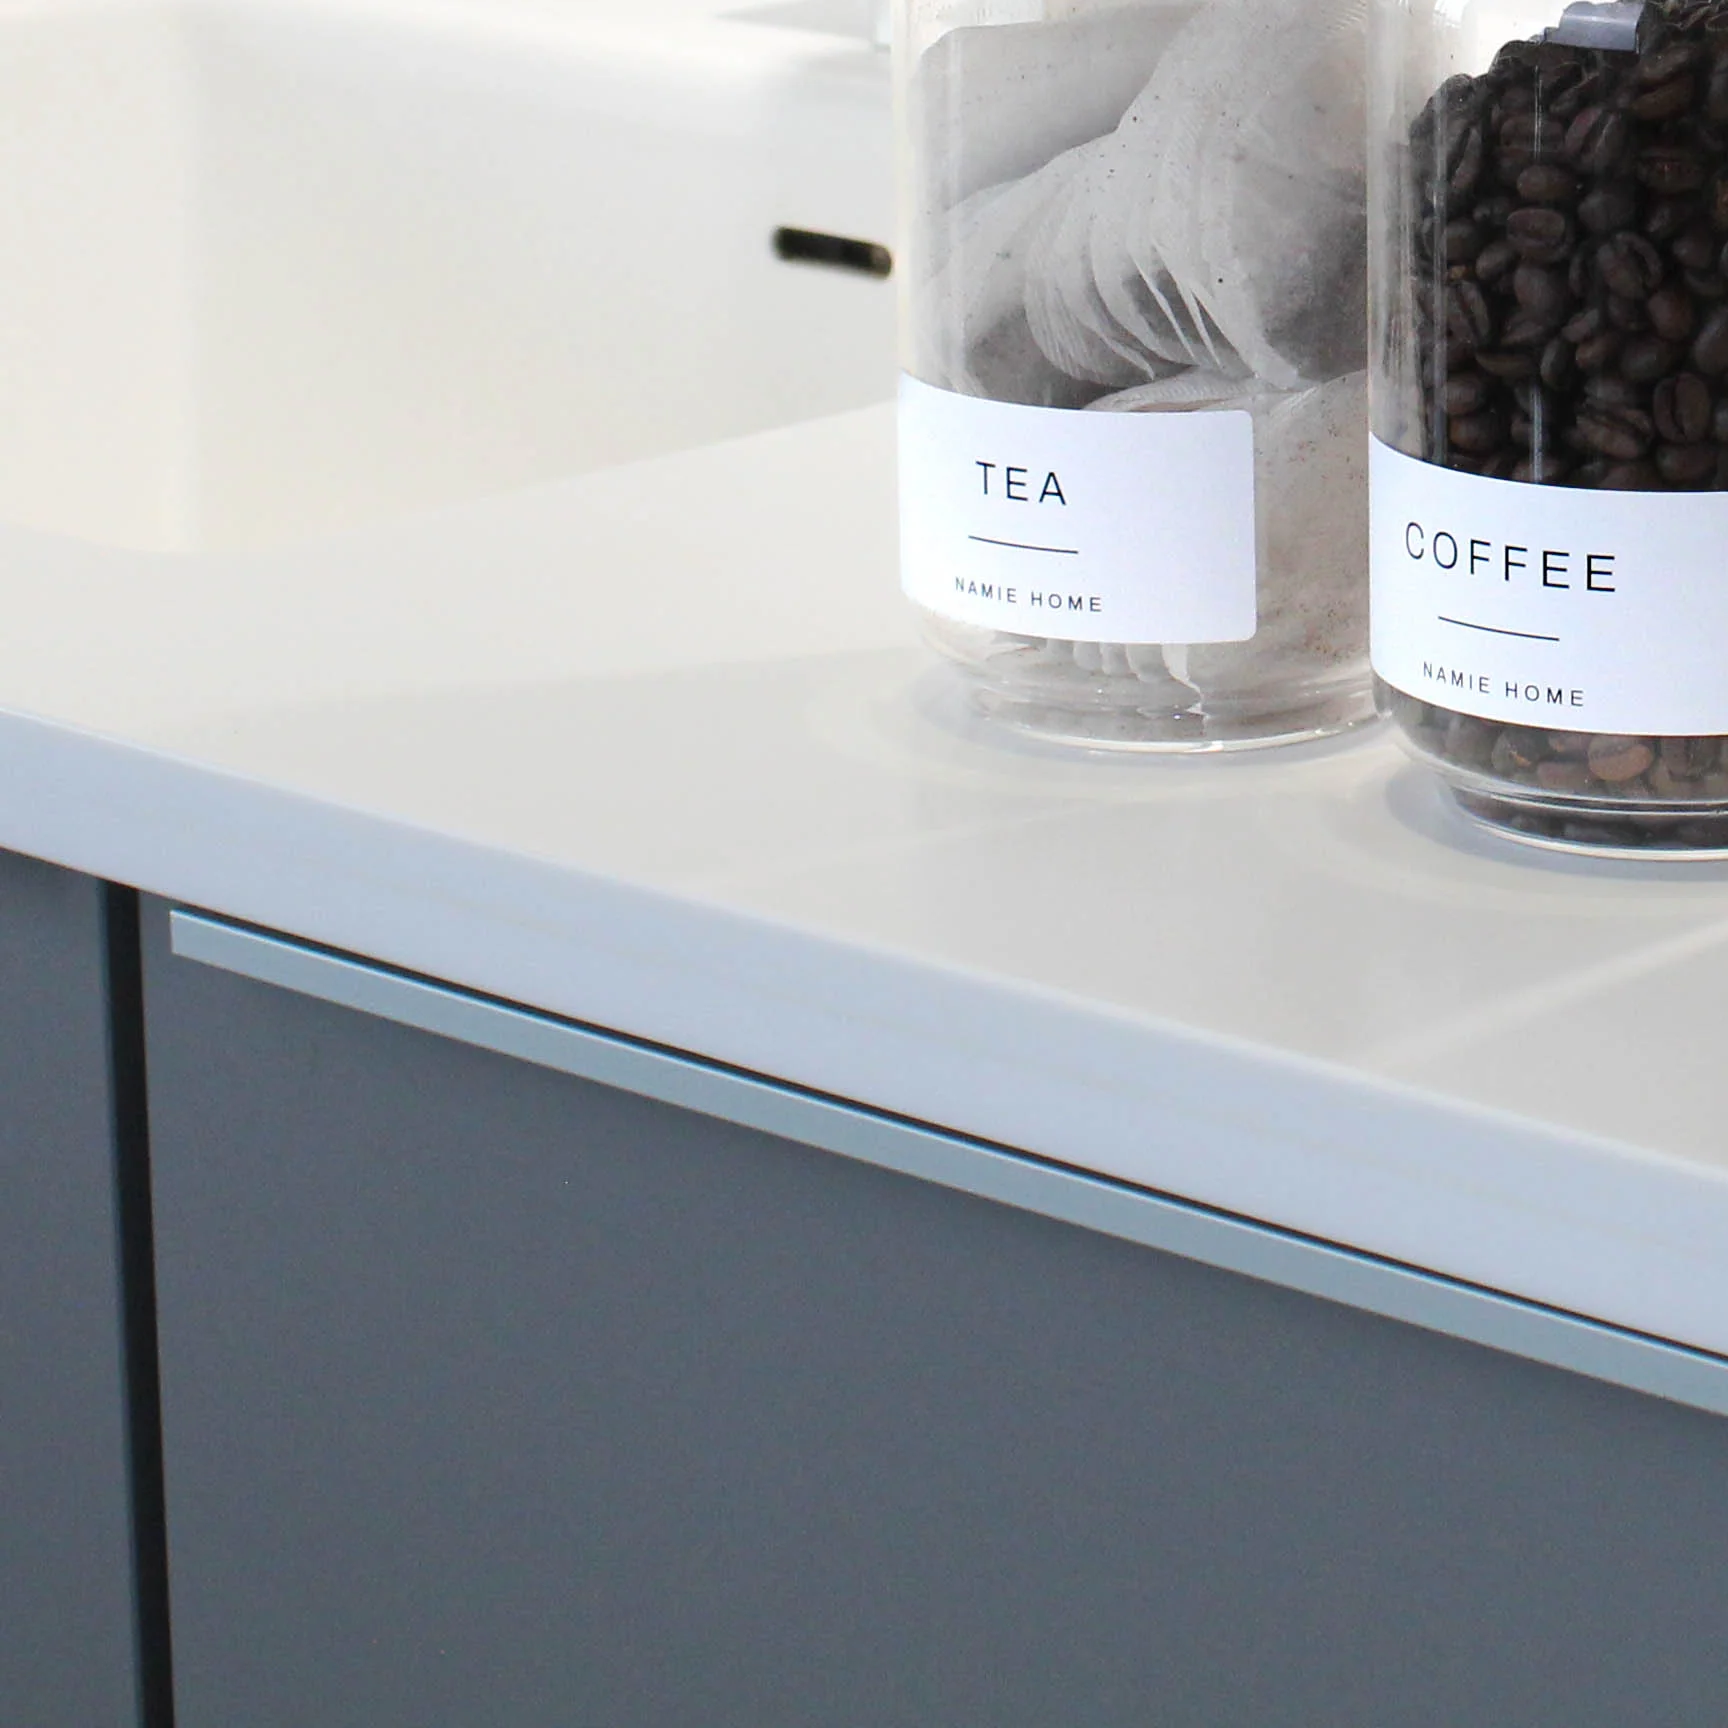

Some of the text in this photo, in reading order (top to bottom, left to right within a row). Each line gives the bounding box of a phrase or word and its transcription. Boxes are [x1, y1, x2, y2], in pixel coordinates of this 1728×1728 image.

[973, 459, 1068, 507] TEA
[1404, 520, 1617, 594] COFFEE
[954, 575, 1103, 613] NAMIE HOME
[1422, 660, 1585, 708] NAMIE HOME
